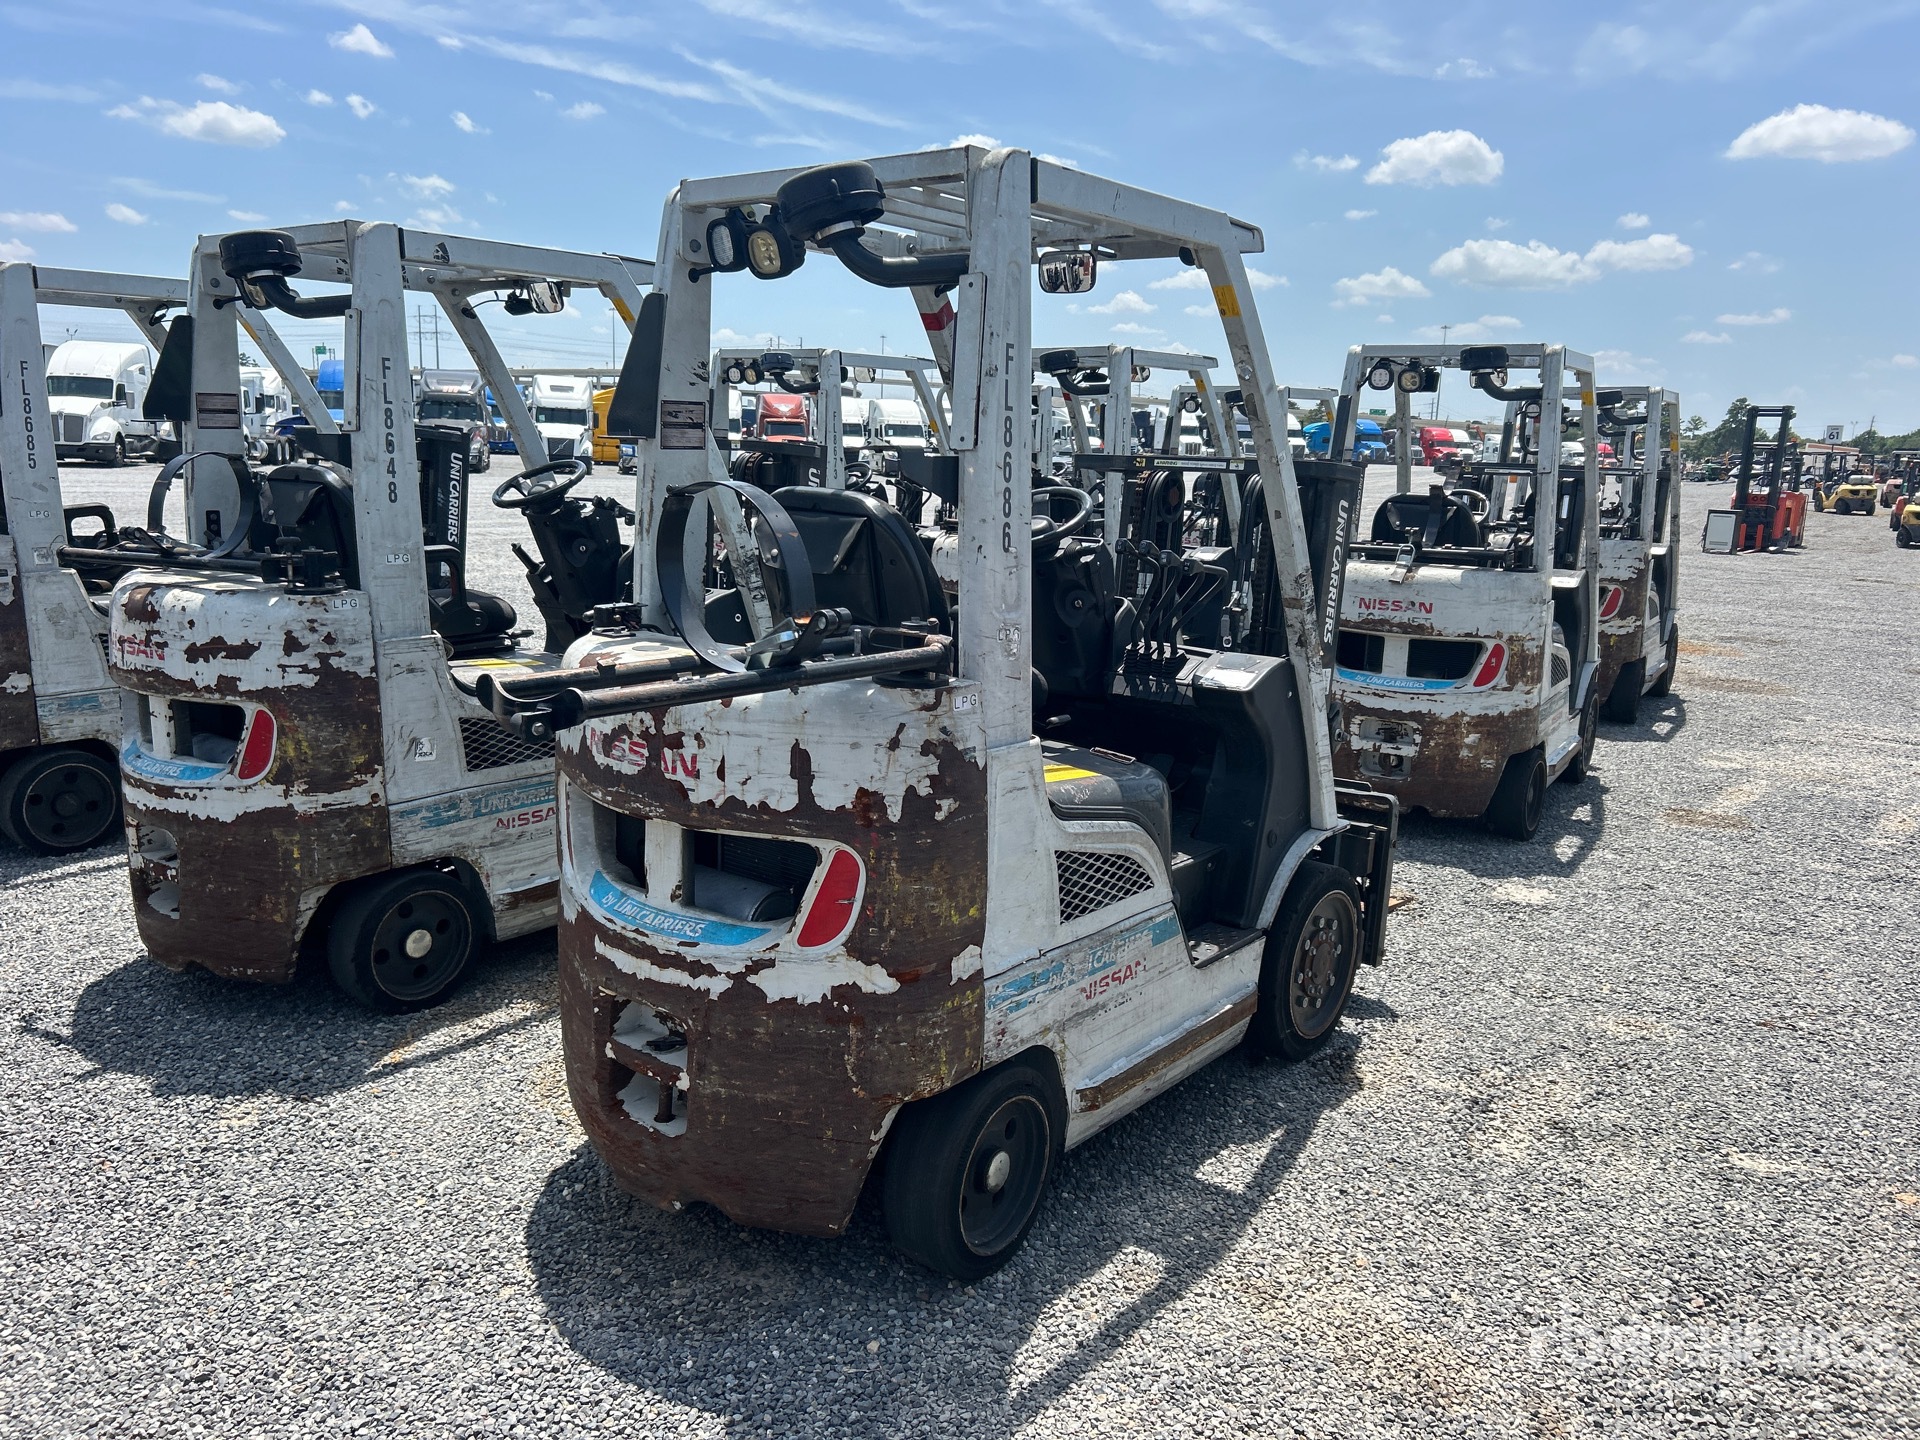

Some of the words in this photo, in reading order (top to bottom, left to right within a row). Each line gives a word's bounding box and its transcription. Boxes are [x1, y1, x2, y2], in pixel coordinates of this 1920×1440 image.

[19, 360, 37, 470] FL8685
[381, 357, 398, 504] FL8648
[1828, 431, 1840, 440] 61
[1002, 342, 1015, 554] FL8686
[447, 452, 463, 544] UNICARRIERS
[29, 510, 50, 518] LPG
[386, 553, 410, 564] LPG
[1323, 499, 1349, 645] UNICARRIERS
[333, 598, 358, 609] LPG
[1358, 597, 1434, 614] NISSAN
[1354, 673, 1366, 682] by
[1366, 675, 1425, 689] UNICARRIERS
[954, 693, 977, 710] LPG
[496, 807, 556, 829] NISSA
[602, 891, 616, 908] by
[614, 896, 709, 937] UNICARRIERS
